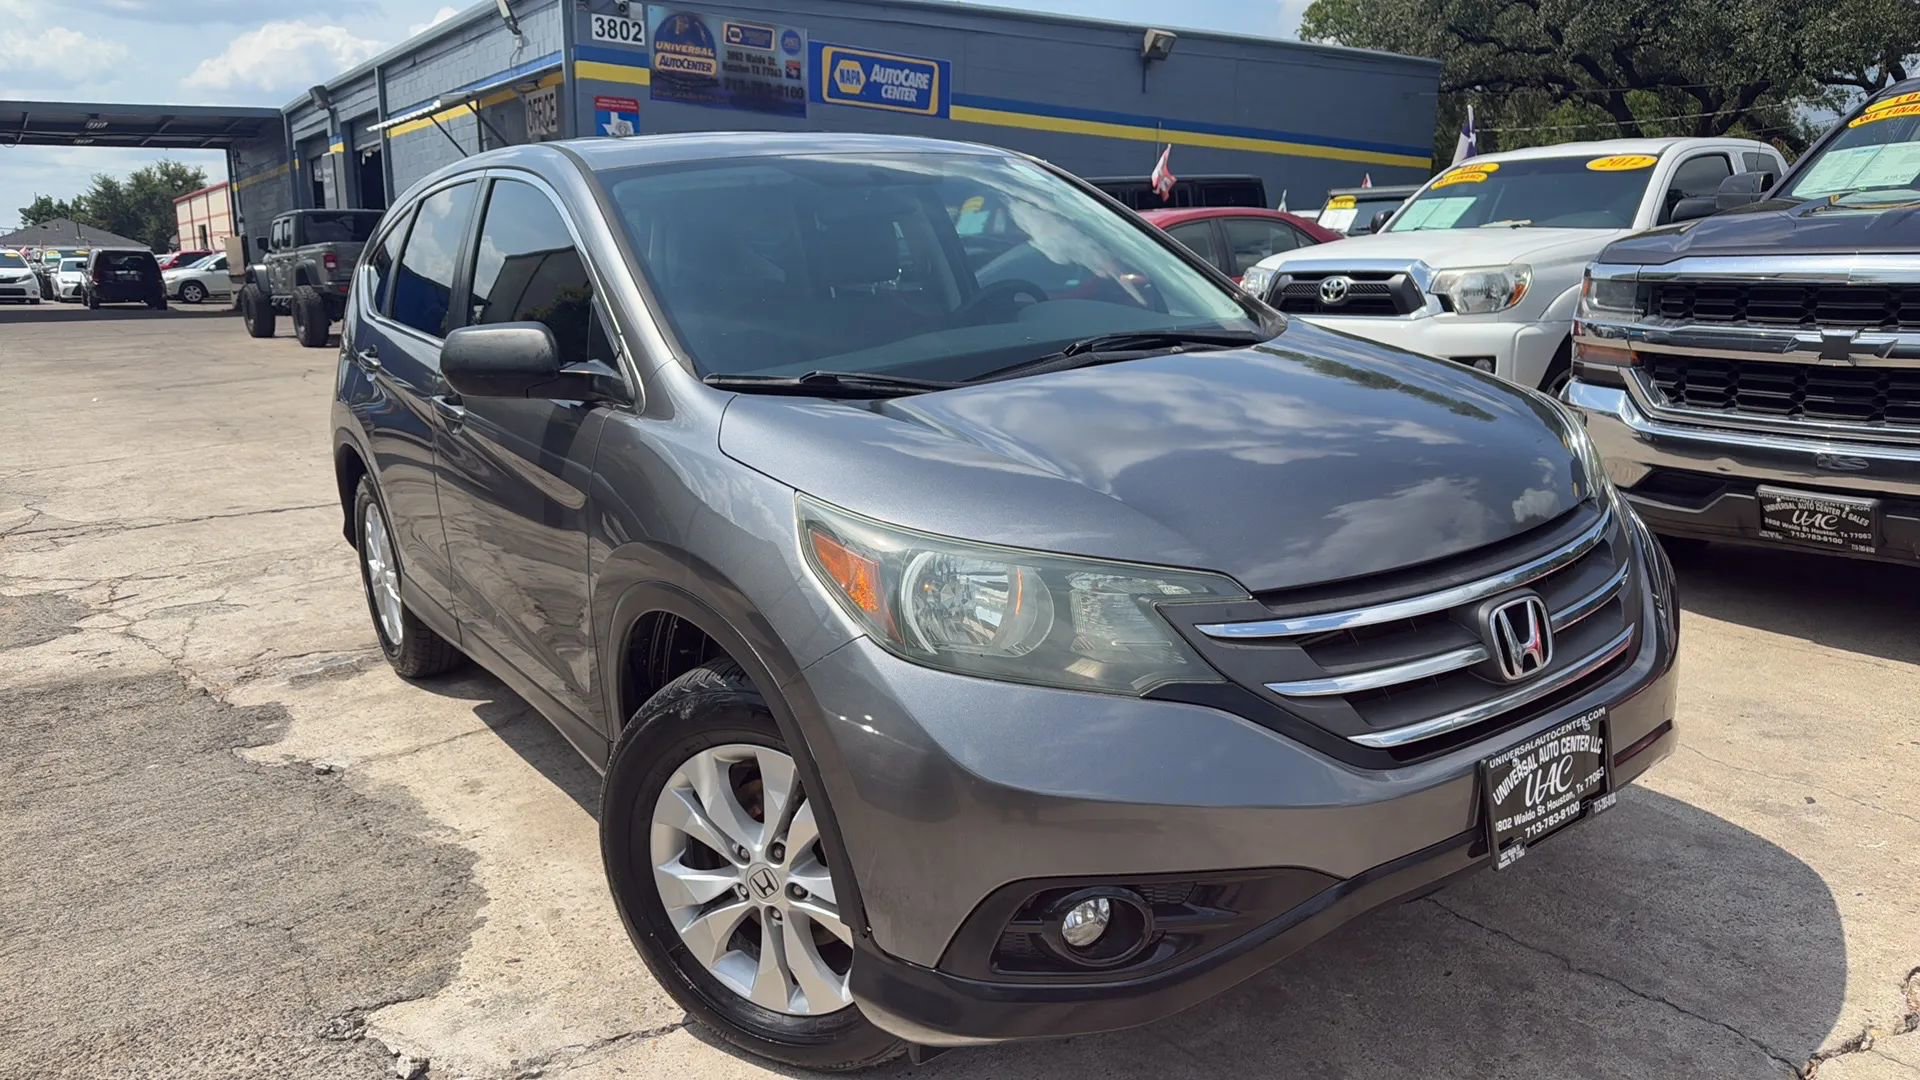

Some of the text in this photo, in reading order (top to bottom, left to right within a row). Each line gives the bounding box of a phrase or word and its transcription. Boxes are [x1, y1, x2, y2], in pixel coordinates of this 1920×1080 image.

[595, 17, 642, 42] 3802
[655, 41, 714, 56] UNIVERSAL
[658, 55, 713, 72] AUTOCENTER
[839, 68, 862, 87] NAPA
[870, 64, 930, 89] AUTOCARE
[881, 85, 918, 102] CENTER
[527, 91, 556, 132] OFFICE
[1860, 112, 1878, 122] WE
[1597, 157, 1648, 167] 2012
[1763, 502, 1797, 512] UNIVERSAL
[1798, 502, 1815, 511] AUTO
[1816, 504, 1841, 515] CENTER
[1847, 513, 1870, 526] SALES
[1792, 510, 1839, 530] UAC
[1791, 530, 1843, 544] 713-783-8100
[1489, 706, 1606, 768] UNIVERSALAUTOCENTER.COM
[1492, 735, 1603, 805] UNIVERSAL AUTO CENTER LLC
[1524, 754, 1575, 807] UAC
[1514, 809, 1536, 826] Waldo
[1537, 804, 1546, 816] St
[1547, 791, 1576, 811] Houston,
[1576, 783, 1584, 795] Tx
[1584, 766, 1605, 788] 77063
[1525, 801, 1581, 838] 713-783-8100
